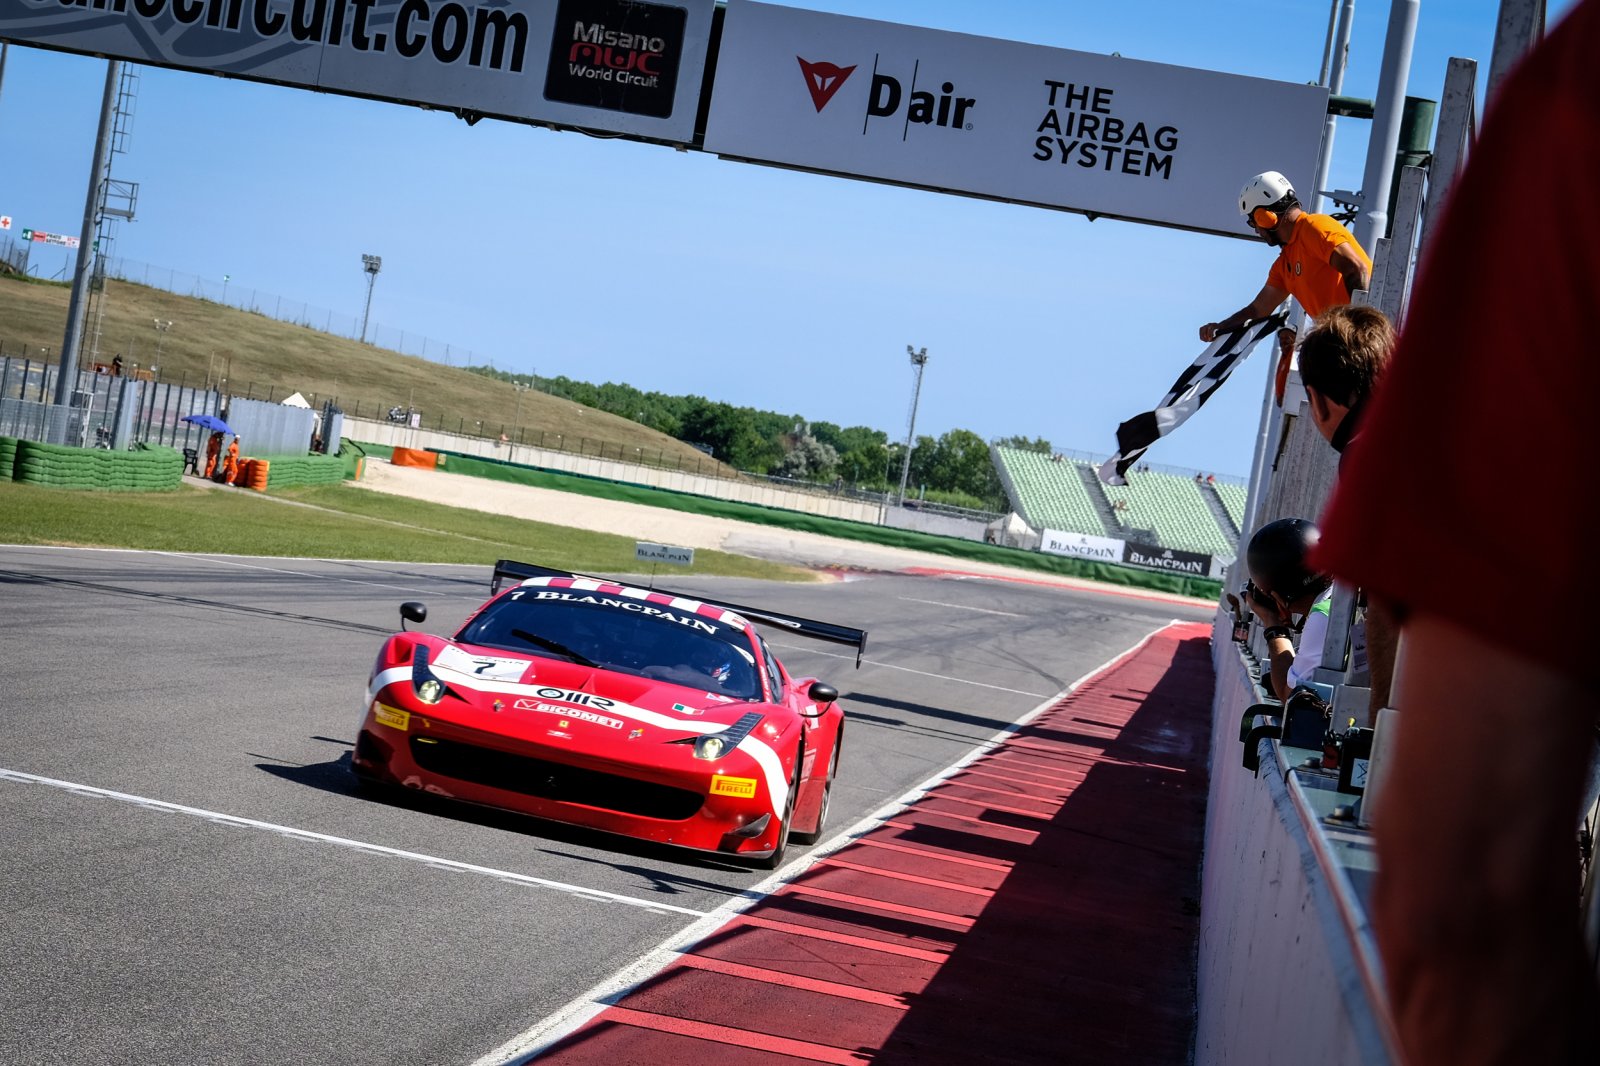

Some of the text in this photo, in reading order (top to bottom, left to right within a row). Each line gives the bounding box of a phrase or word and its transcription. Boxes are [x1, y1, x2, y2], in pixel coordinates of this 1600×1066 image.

[58, 0, 528, 73] cuit.com
[573, 21, 665, 53] Misano
[568, 63, 659, 88] World Circuit
[1044, 79, 1114, 114] THE
[1036, 108, 1179, 152] AIRBAG
[1032, 135, 1173, 180] SYSTEM
[637, 548, 690, 562] BLANCPAIN
[1049, 540, 1116, 558] BLANCPAIN
[1129, 551, 1203, 573] BLANCPAIN
[510, 590, 526, 601] 7
[534, 590, 720, 635] BLANCPAIN
[471, 660, 497, 675] 7
[536, 703, 621, 729] BICOMET
[715, 779, 753, 795] PIRELLI
